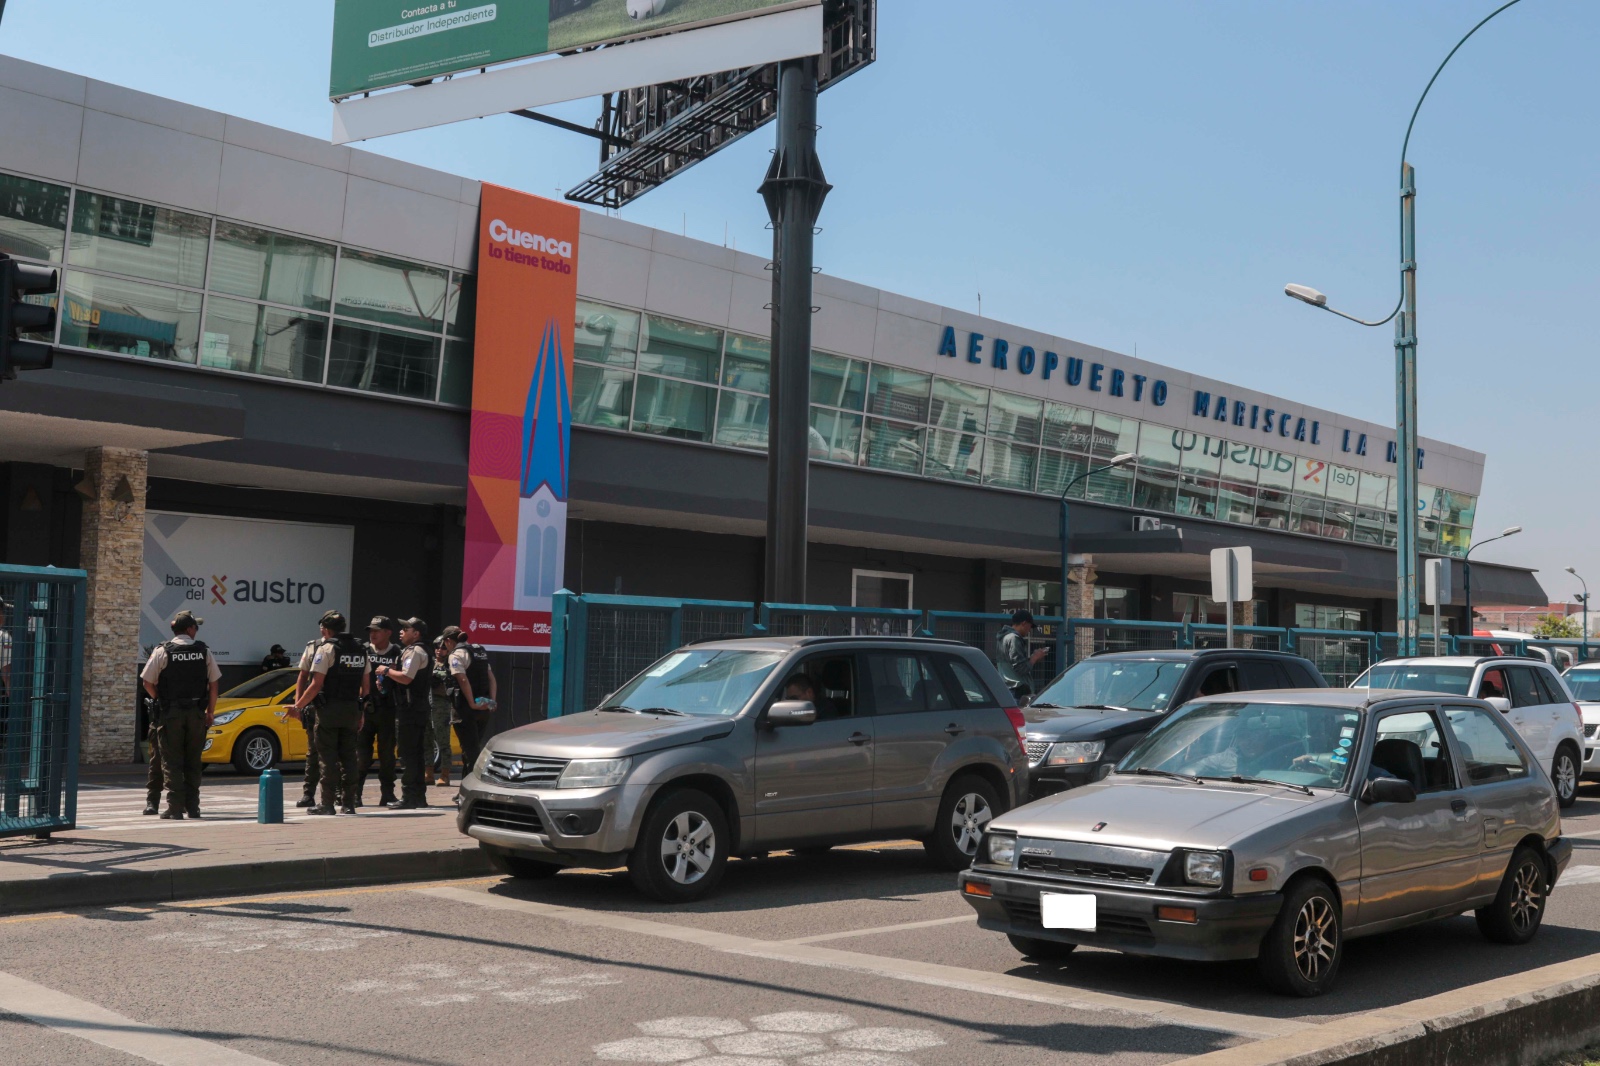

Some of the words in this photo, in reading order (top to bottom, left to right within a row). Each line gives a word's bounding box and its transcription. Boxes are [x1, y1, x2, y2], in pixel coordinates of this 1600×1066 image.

[401, 4, 438, 19] Contacta
[448, 0, 457, 8] tu
[370, 23, 424, 44] Distribuidor
[427, 8, 494, 31] Independiente
[489, 219, 572, 258] Cuenca
[488, 242, 503, 259] lo
[504, 247, 539, 268] tiene
[541, 256, 572, 275] todo
[939, 326, 1168, 406] AEROPUERTO
[1193, 390, 1320, 445] MARISCAL
[1343, 428, 1368, 457] LA
[1386, 440, 1425, 470] MR
[166, 574, 205, 587] banco
[186, 588, 205, 600] del
[233, 578, 325, 605] austro
[172, 652, 205, 662] POLICIA
